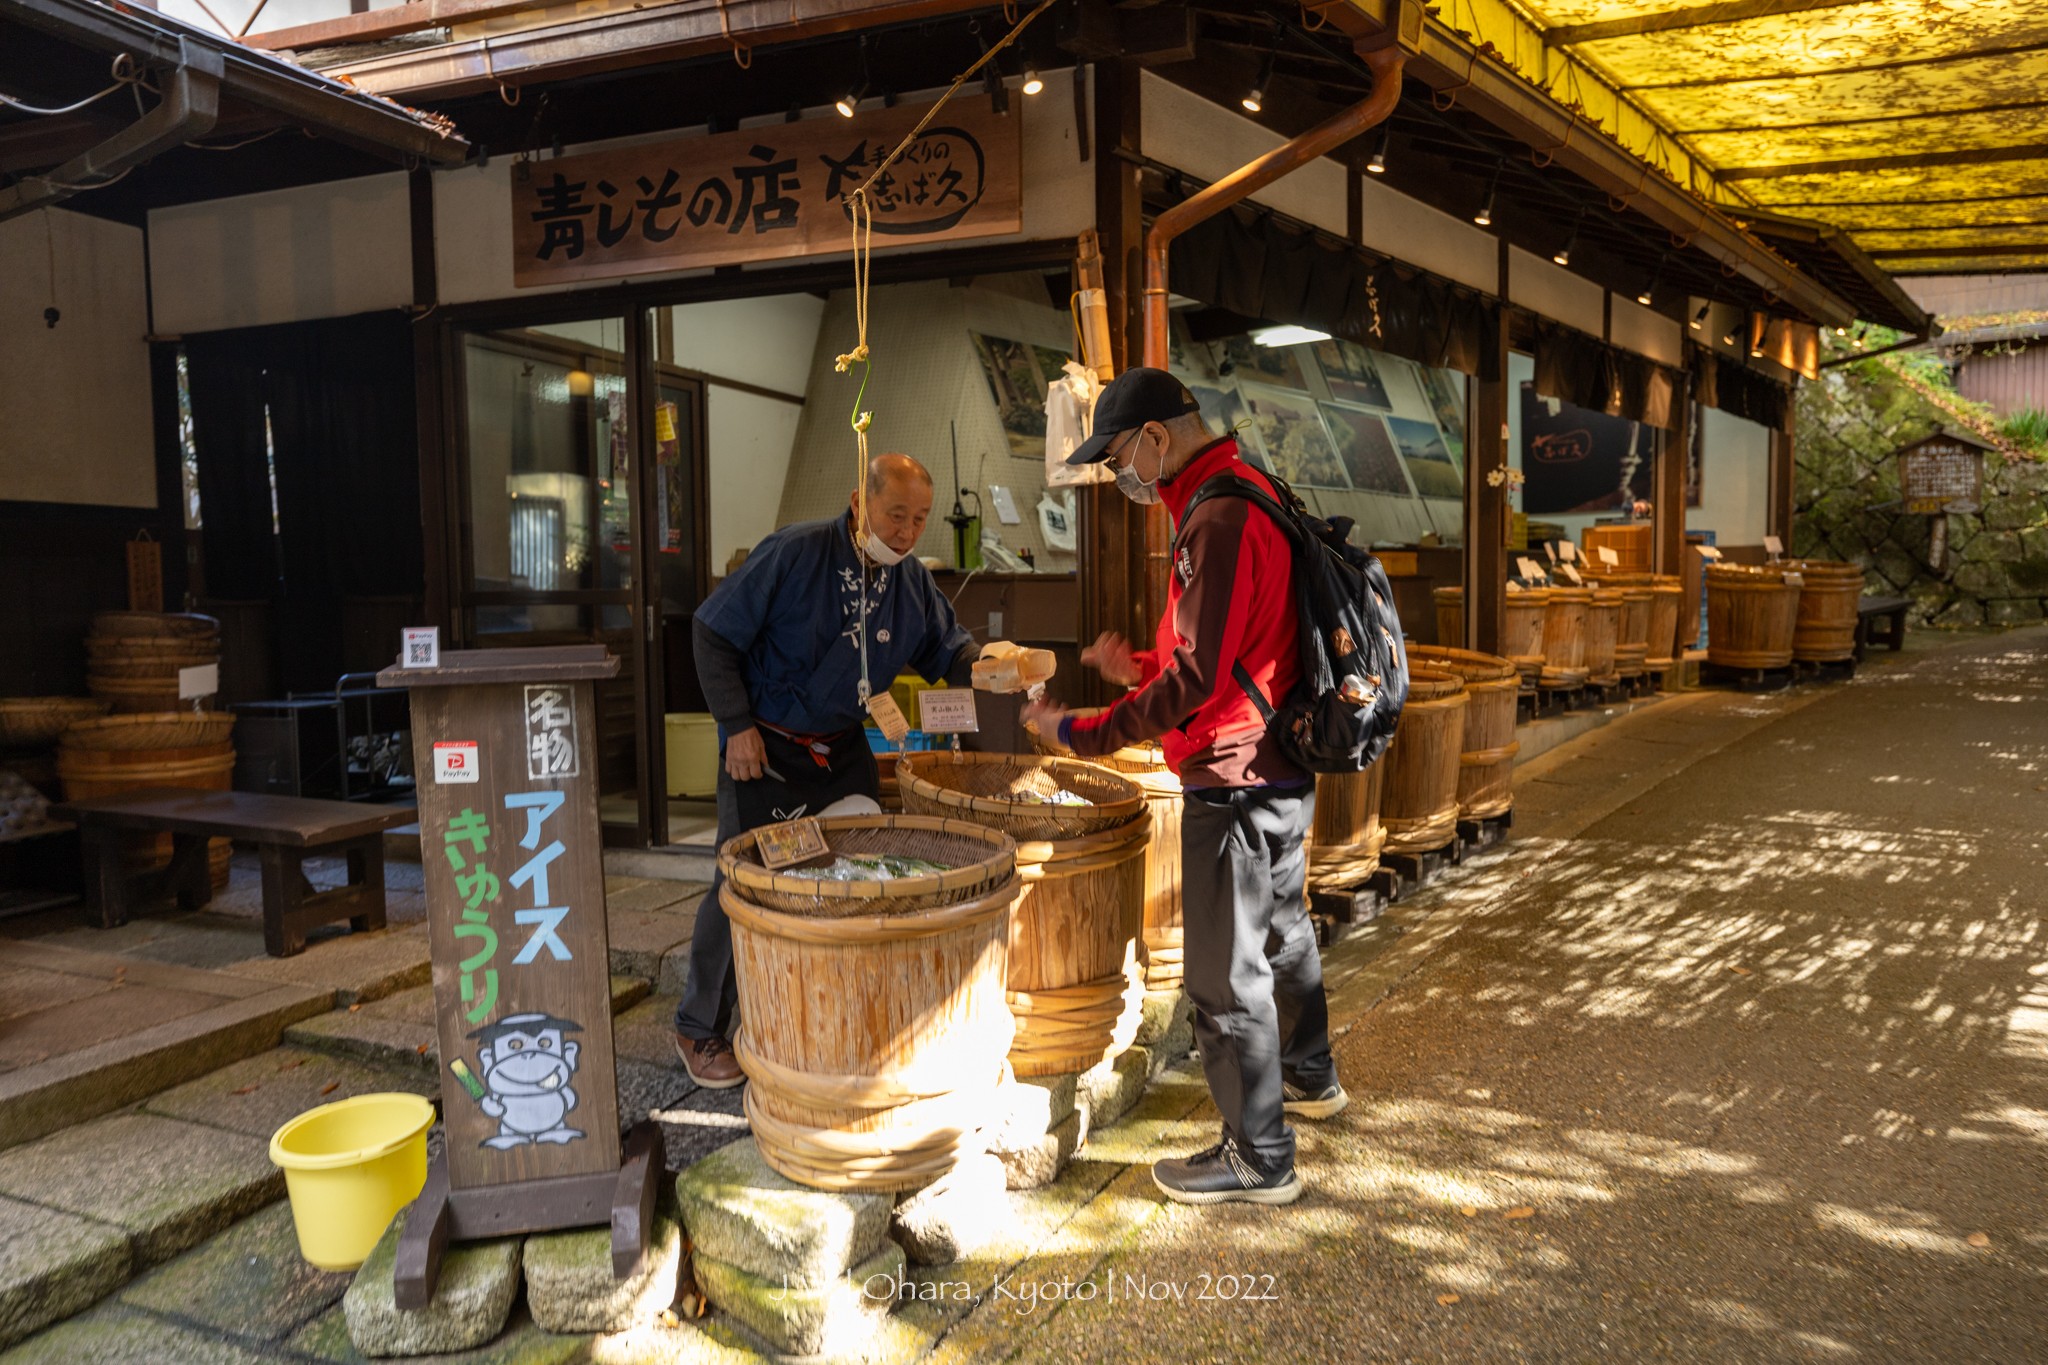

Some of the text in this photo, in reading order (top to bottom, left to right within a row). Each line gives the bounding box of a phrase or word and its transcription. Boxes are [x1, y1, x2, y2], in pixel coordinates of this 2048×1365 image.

[530, 143, 801, 261] 青しその店
[443, 770, 470, 778] PayPay
[527, 690, 574, 773] 名物
[444, 808, 500, 1023] きゅうり
[504, 791, 572, 964] アイス
